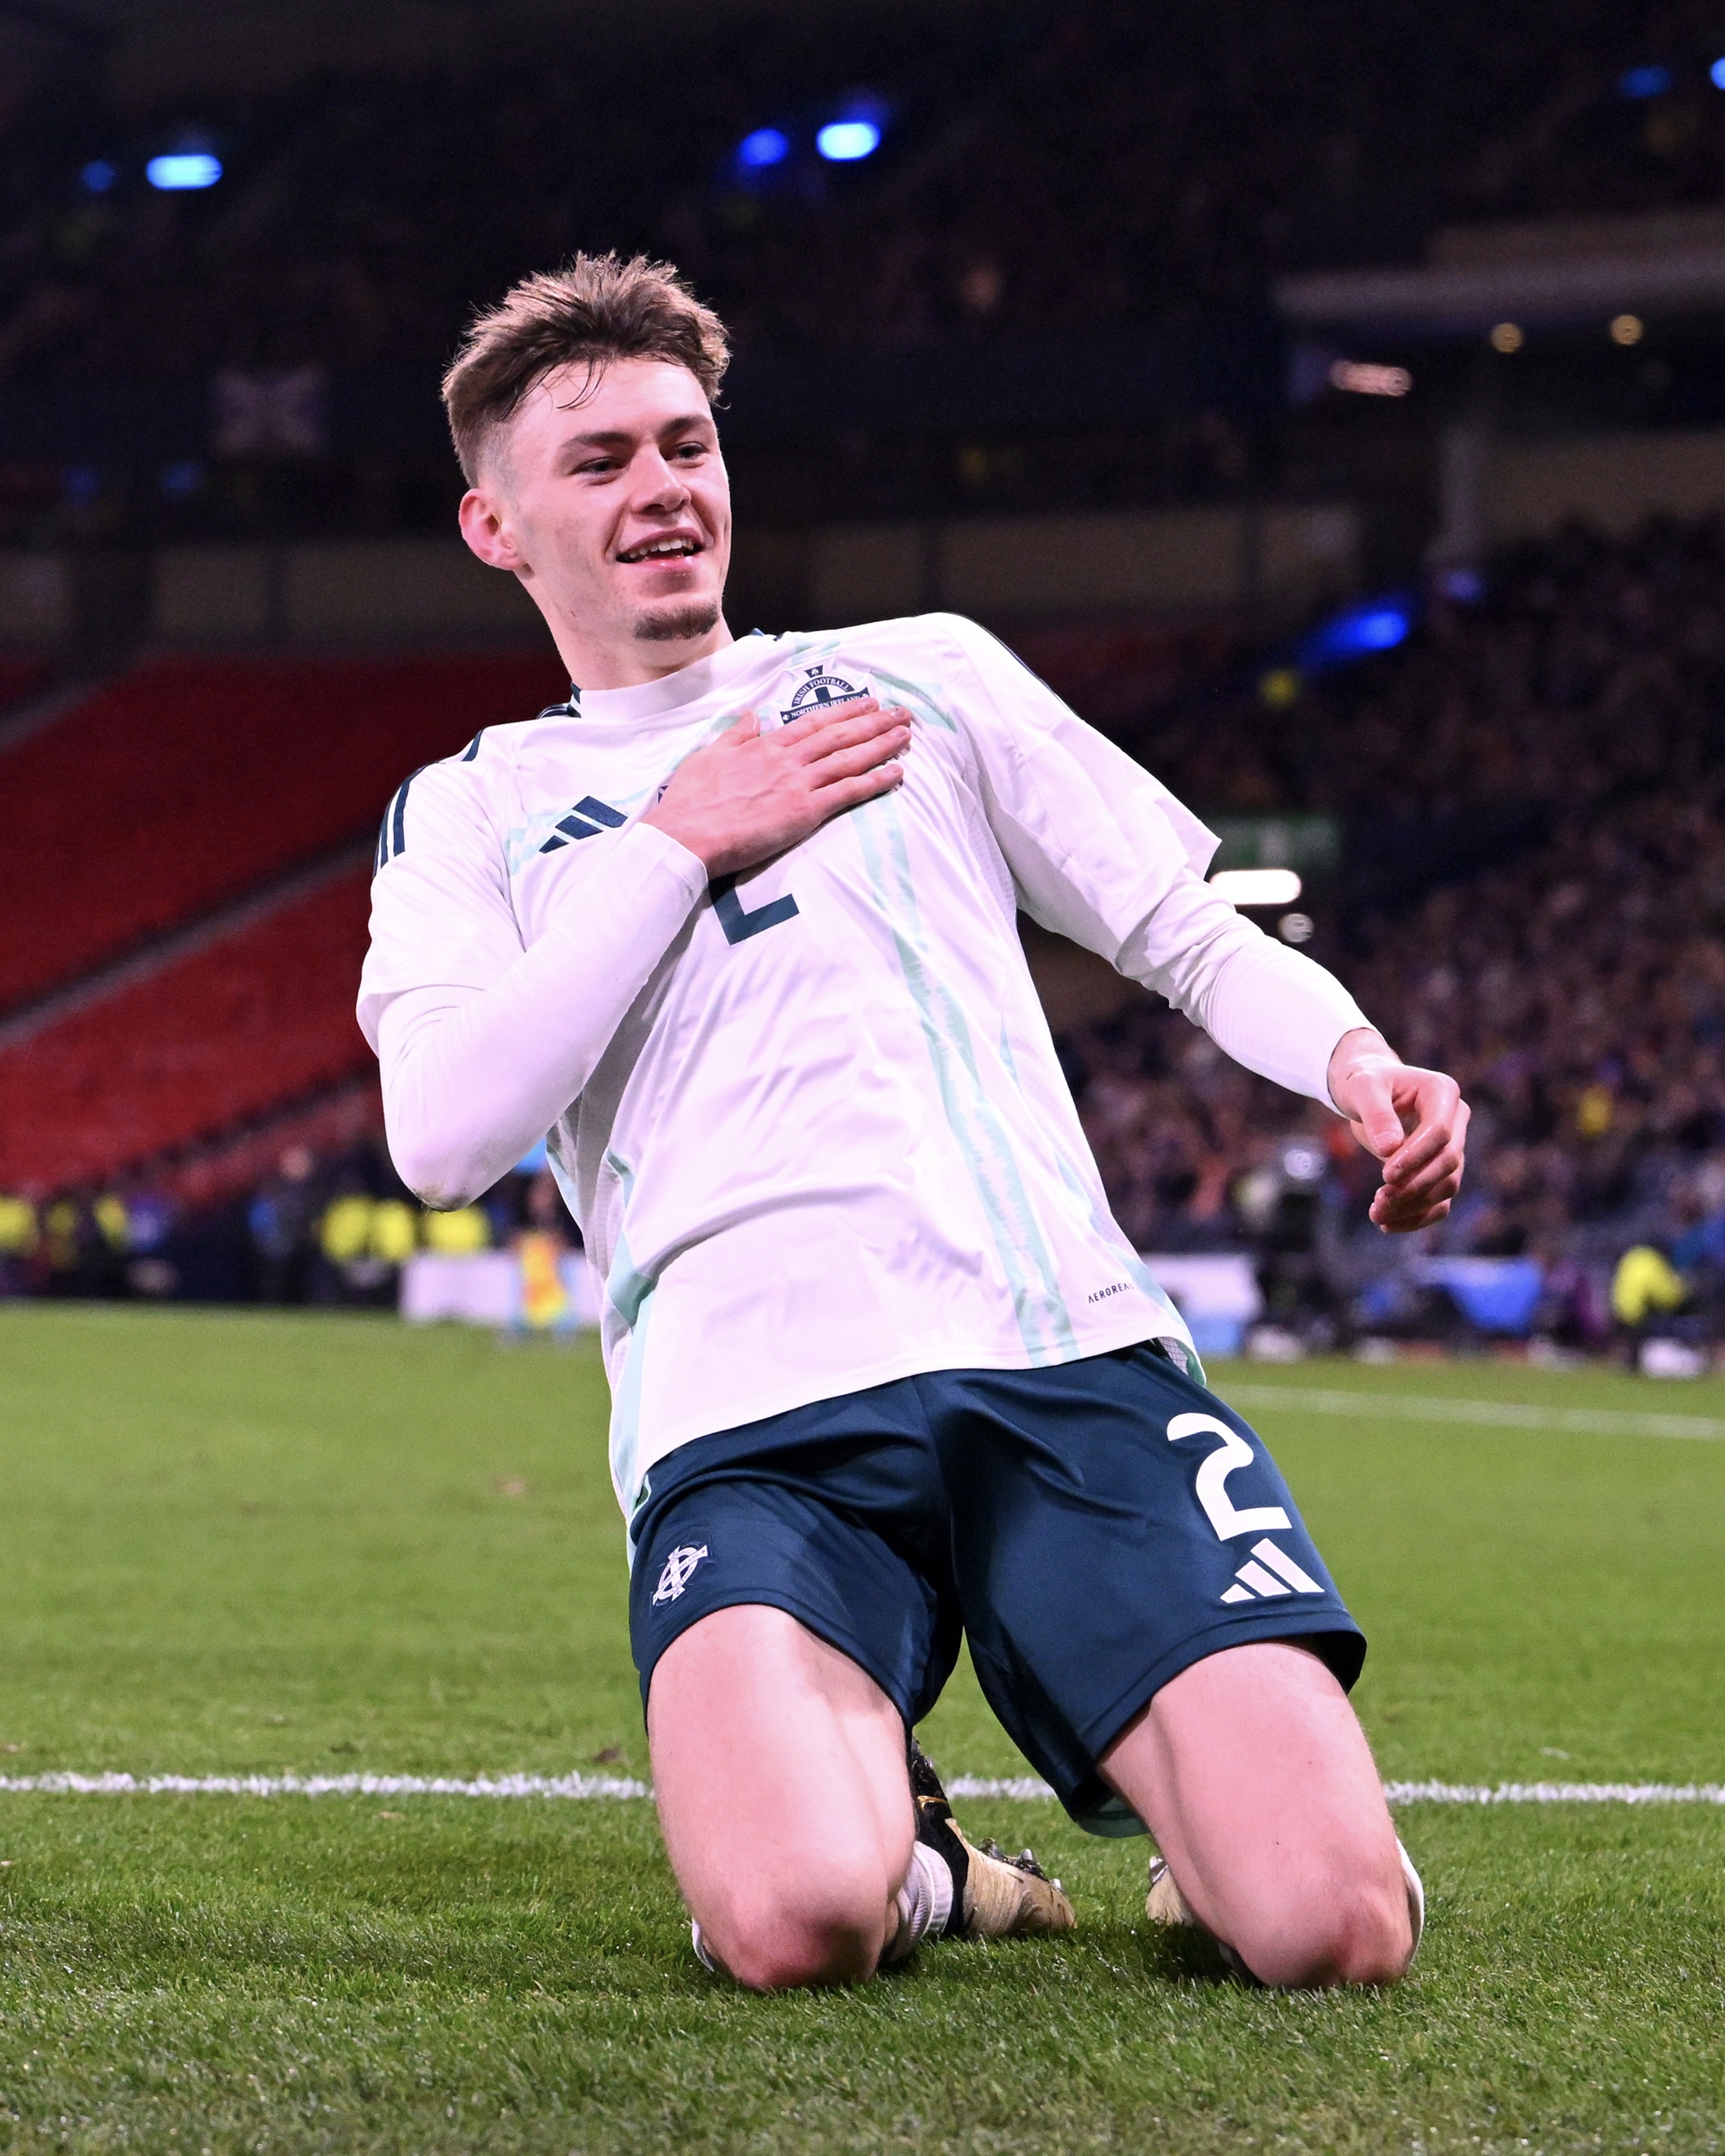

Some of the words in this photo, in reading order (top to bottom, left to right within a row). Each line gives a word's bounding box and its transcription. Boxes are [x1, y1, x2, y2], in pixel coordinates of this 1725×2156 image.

[793, 685, 810, 704] IRISH
[808, 677, 849, 692] FOOTBALL
[1088, 1283, 1134, 1304] AEROREA
[1167, 1412, 1293, 1541] 2
